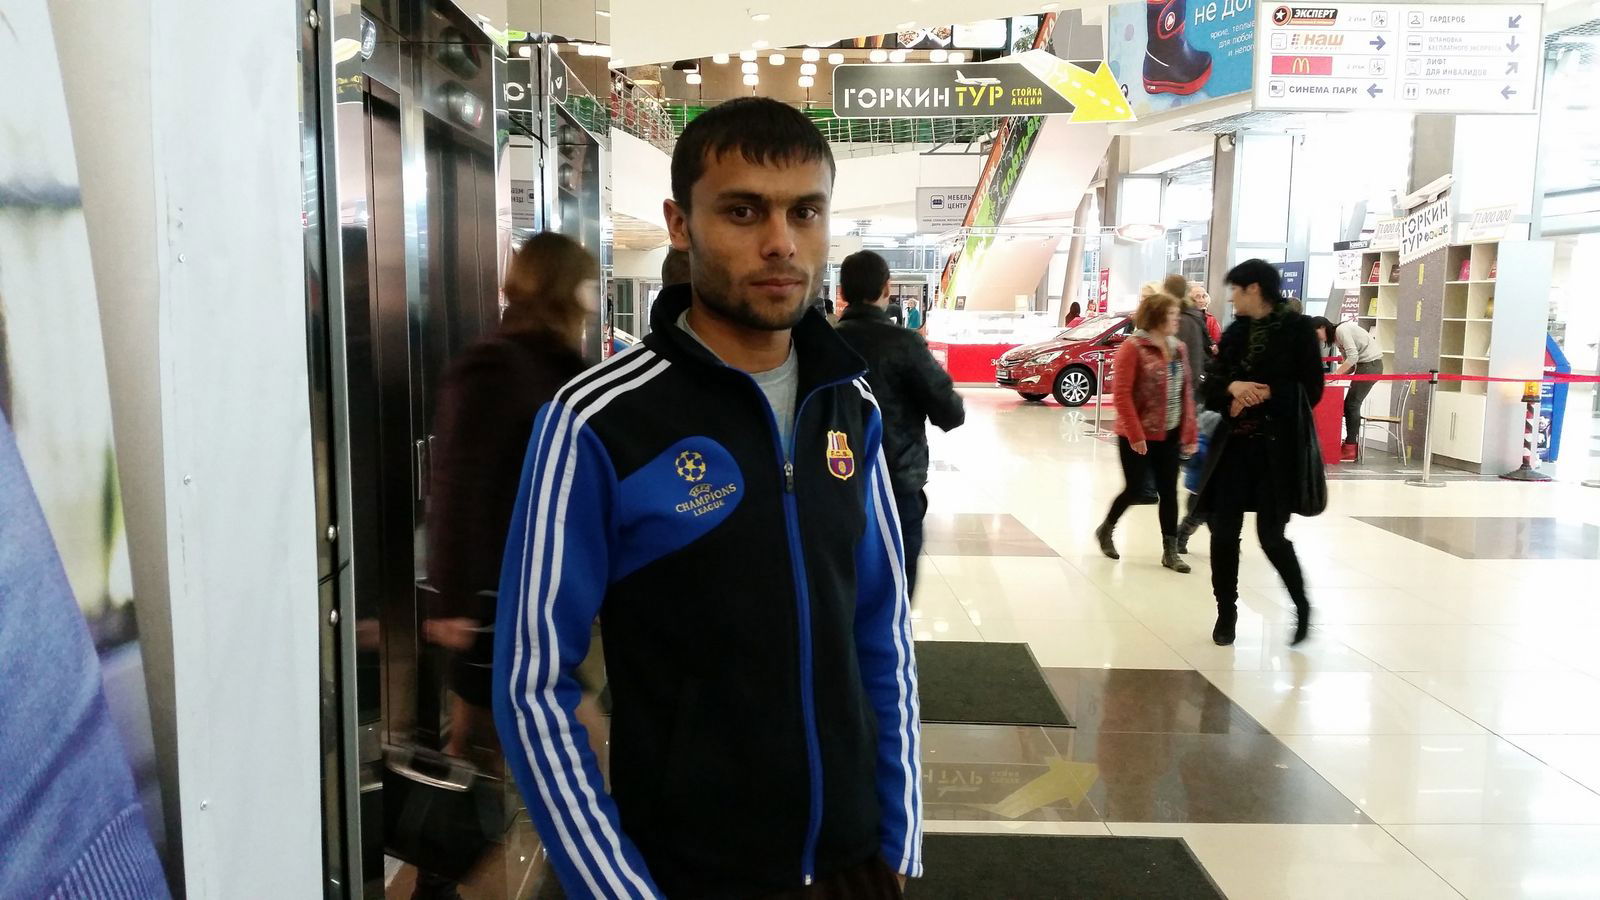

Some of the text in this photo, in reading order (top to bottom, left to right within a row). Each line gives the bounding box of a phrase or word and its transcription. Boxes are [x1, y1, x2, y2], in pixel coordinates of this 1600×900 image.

[1295, 9, 1336, 18] ЭКСПЕРТ
[1011, 87, 1042, 97] СТОЙКА
[1289, 85, 1358, 95] СИНЕМА ПАРК
[1425, 88, 1451, 96] ТУАЛЕТ
[1011, 97, 1042, 106] АКЦИИ
[1402, 201, 1448, 238] ГОРКИН
[1402, 233, 1423, 255] ТУР
[675, 483, 737, 513] CHAMPIONS
[693, 500, 726, 516] LEAGUE
